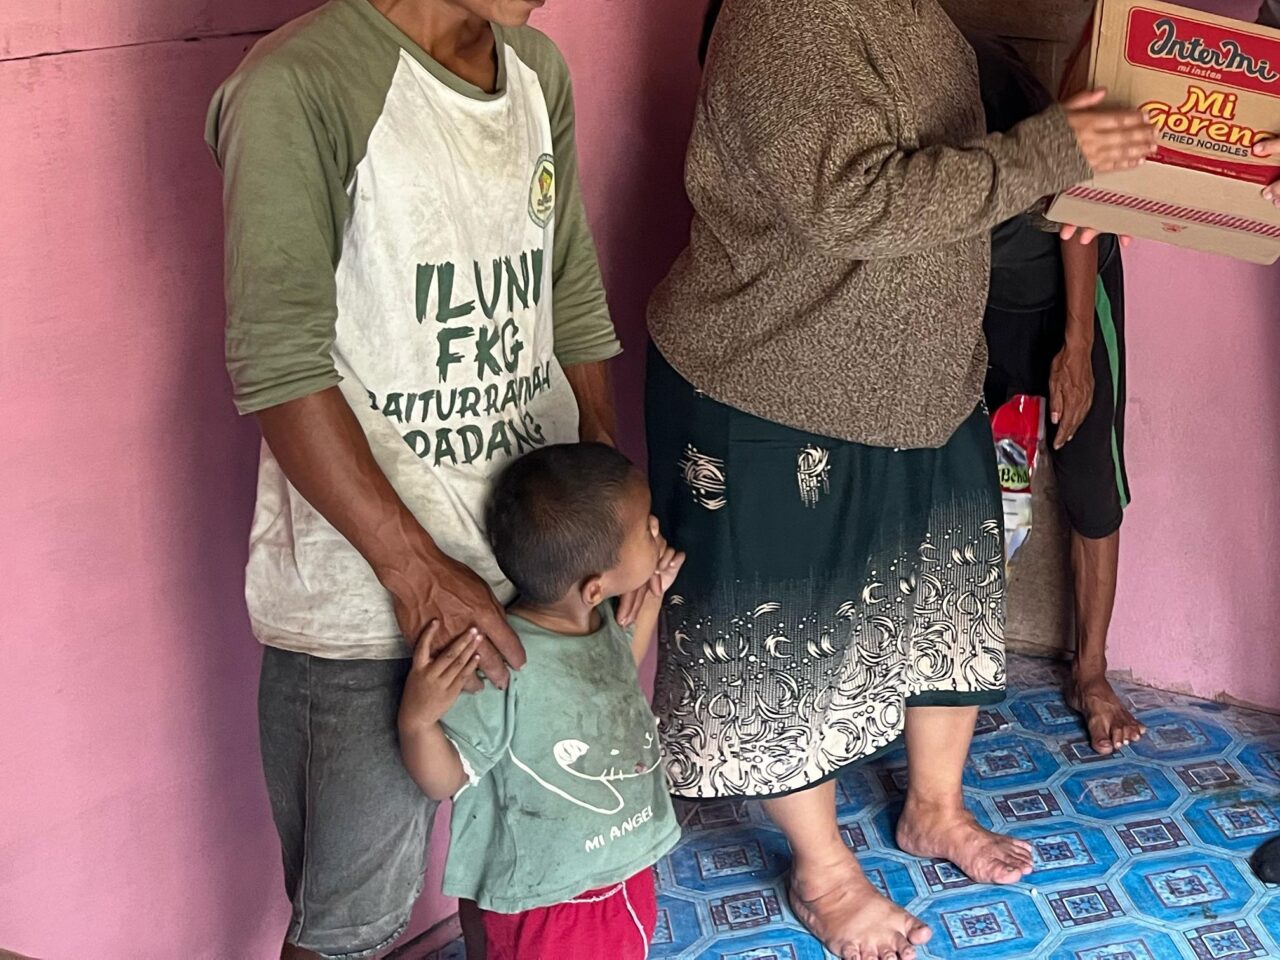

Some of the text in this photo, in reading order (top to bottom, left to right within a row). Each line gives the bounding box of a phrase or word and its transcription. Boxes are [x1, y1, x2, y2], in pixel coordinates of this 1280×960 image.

[1177, 85, 1238, 120] Mi
[1161, 131, 1249, 158] FRIED NOODLES
[415, 248, 543, 324] ILUNI
[436, 317, 523, 383] FKG
[585, 805, 653, 853] MI ANGEL
